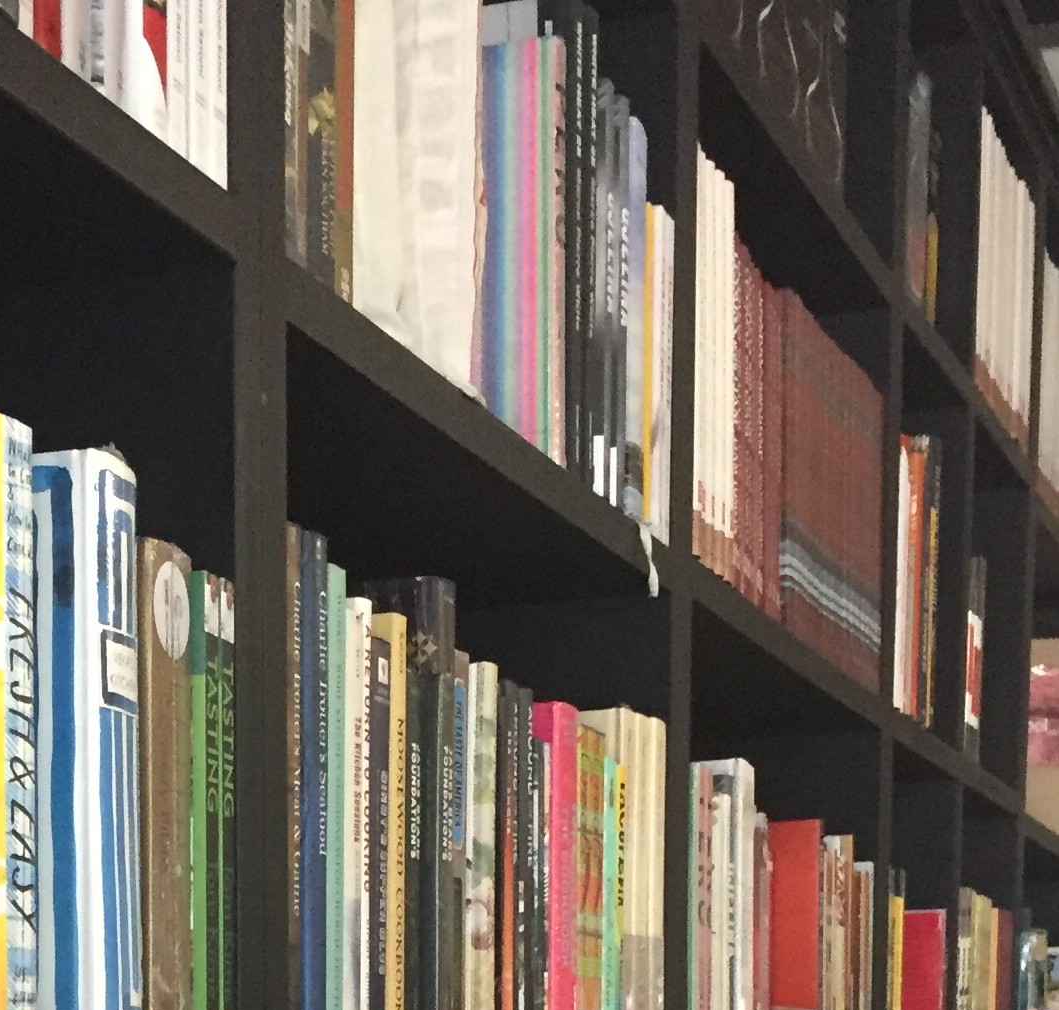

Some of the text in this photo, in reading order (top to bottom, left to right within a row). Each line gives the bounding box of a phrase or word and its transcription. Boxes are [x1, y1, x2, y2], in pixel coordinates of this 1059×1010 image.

[8, 754, 36, 791] &
[206, 655, 220, 814] TASTING
[221, 661, 236, 818] TASTING
[396, 717, 405, 877] MOOSEWOOD
[10, 799, 38, 936] EASY
[362, 789, 371, 893] COOKING
